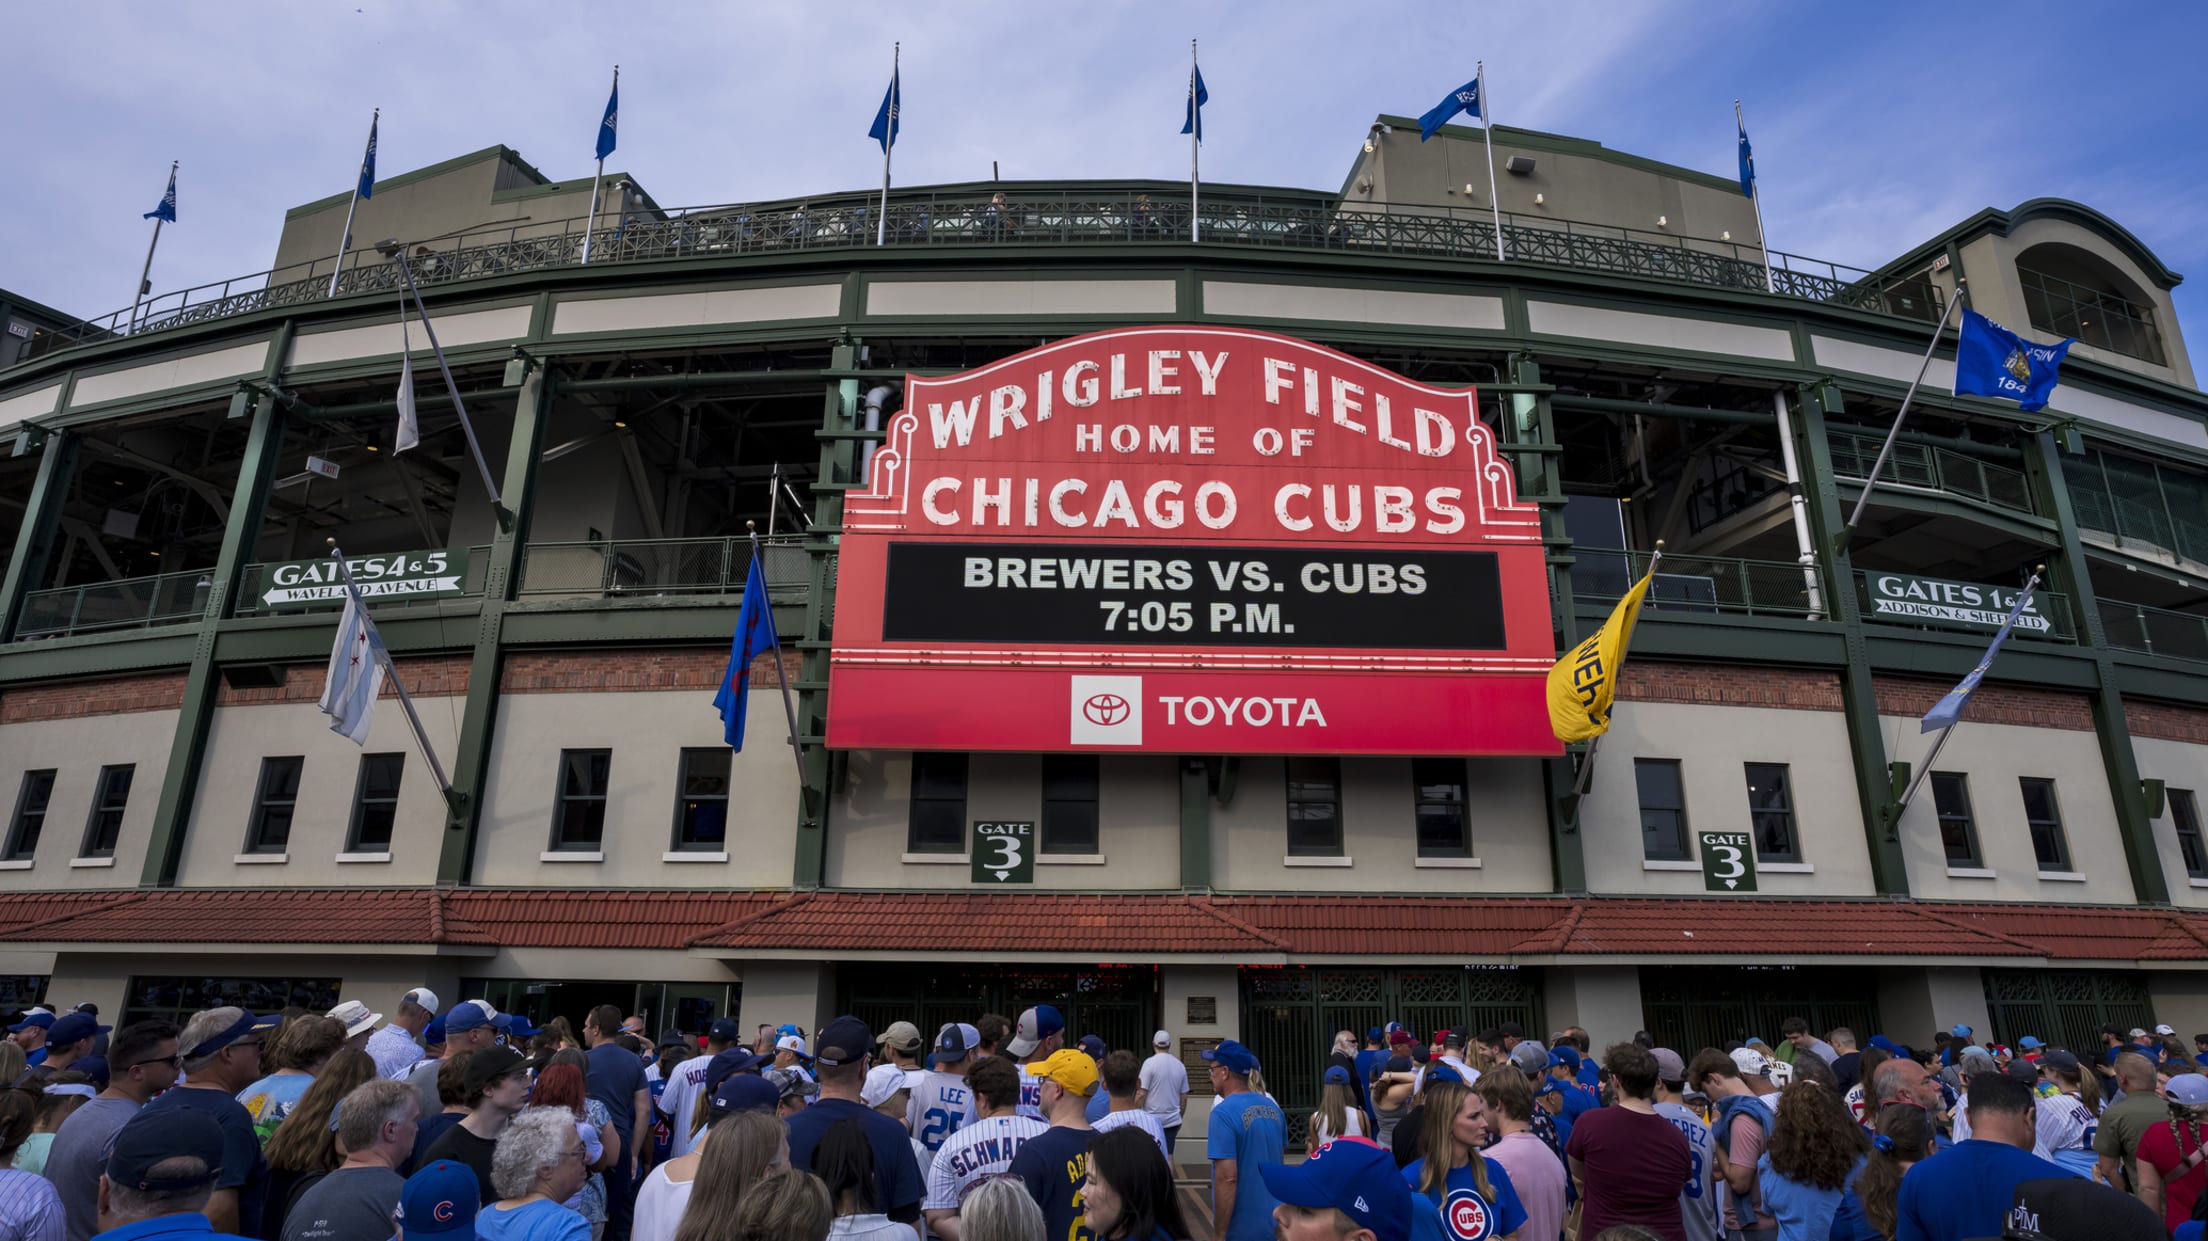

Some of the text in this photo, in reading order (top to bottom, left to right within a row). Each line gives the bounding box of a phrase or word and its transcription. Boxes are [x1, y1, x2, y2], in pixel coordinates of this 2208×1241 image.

[928, 350, 1455, 457] WRIGLEY FIELD
[1076, 424, 1315, 456] HOME OF
[921, 476, 1466, 535] CHICAGO CUBS
[273, 558, 385, 586] GATES
[964, 557, 1428, 595] BREWERS VS. CUBS
[287, 579, 435, 600] WAVELAD AVENUE
[1878, 576, 1983, 606] GATES
[1099, 601, 1295, 634] 7:05 P.M.
[1882, 602, 1950, 618] ADDISON
[1954, 609, 1965, 619] &
[1159, 696, 1327, 727] TOYOTA
[977, 824, 1030, 835] GATE
[1703, 834, 1748, 845] GATE
[984, 836, 1022, 869] 3
[1712, 846, 1746, 878] 3
[940, 1086, 966, 1105] LEE
[433, 1200, 454, 1222] C
